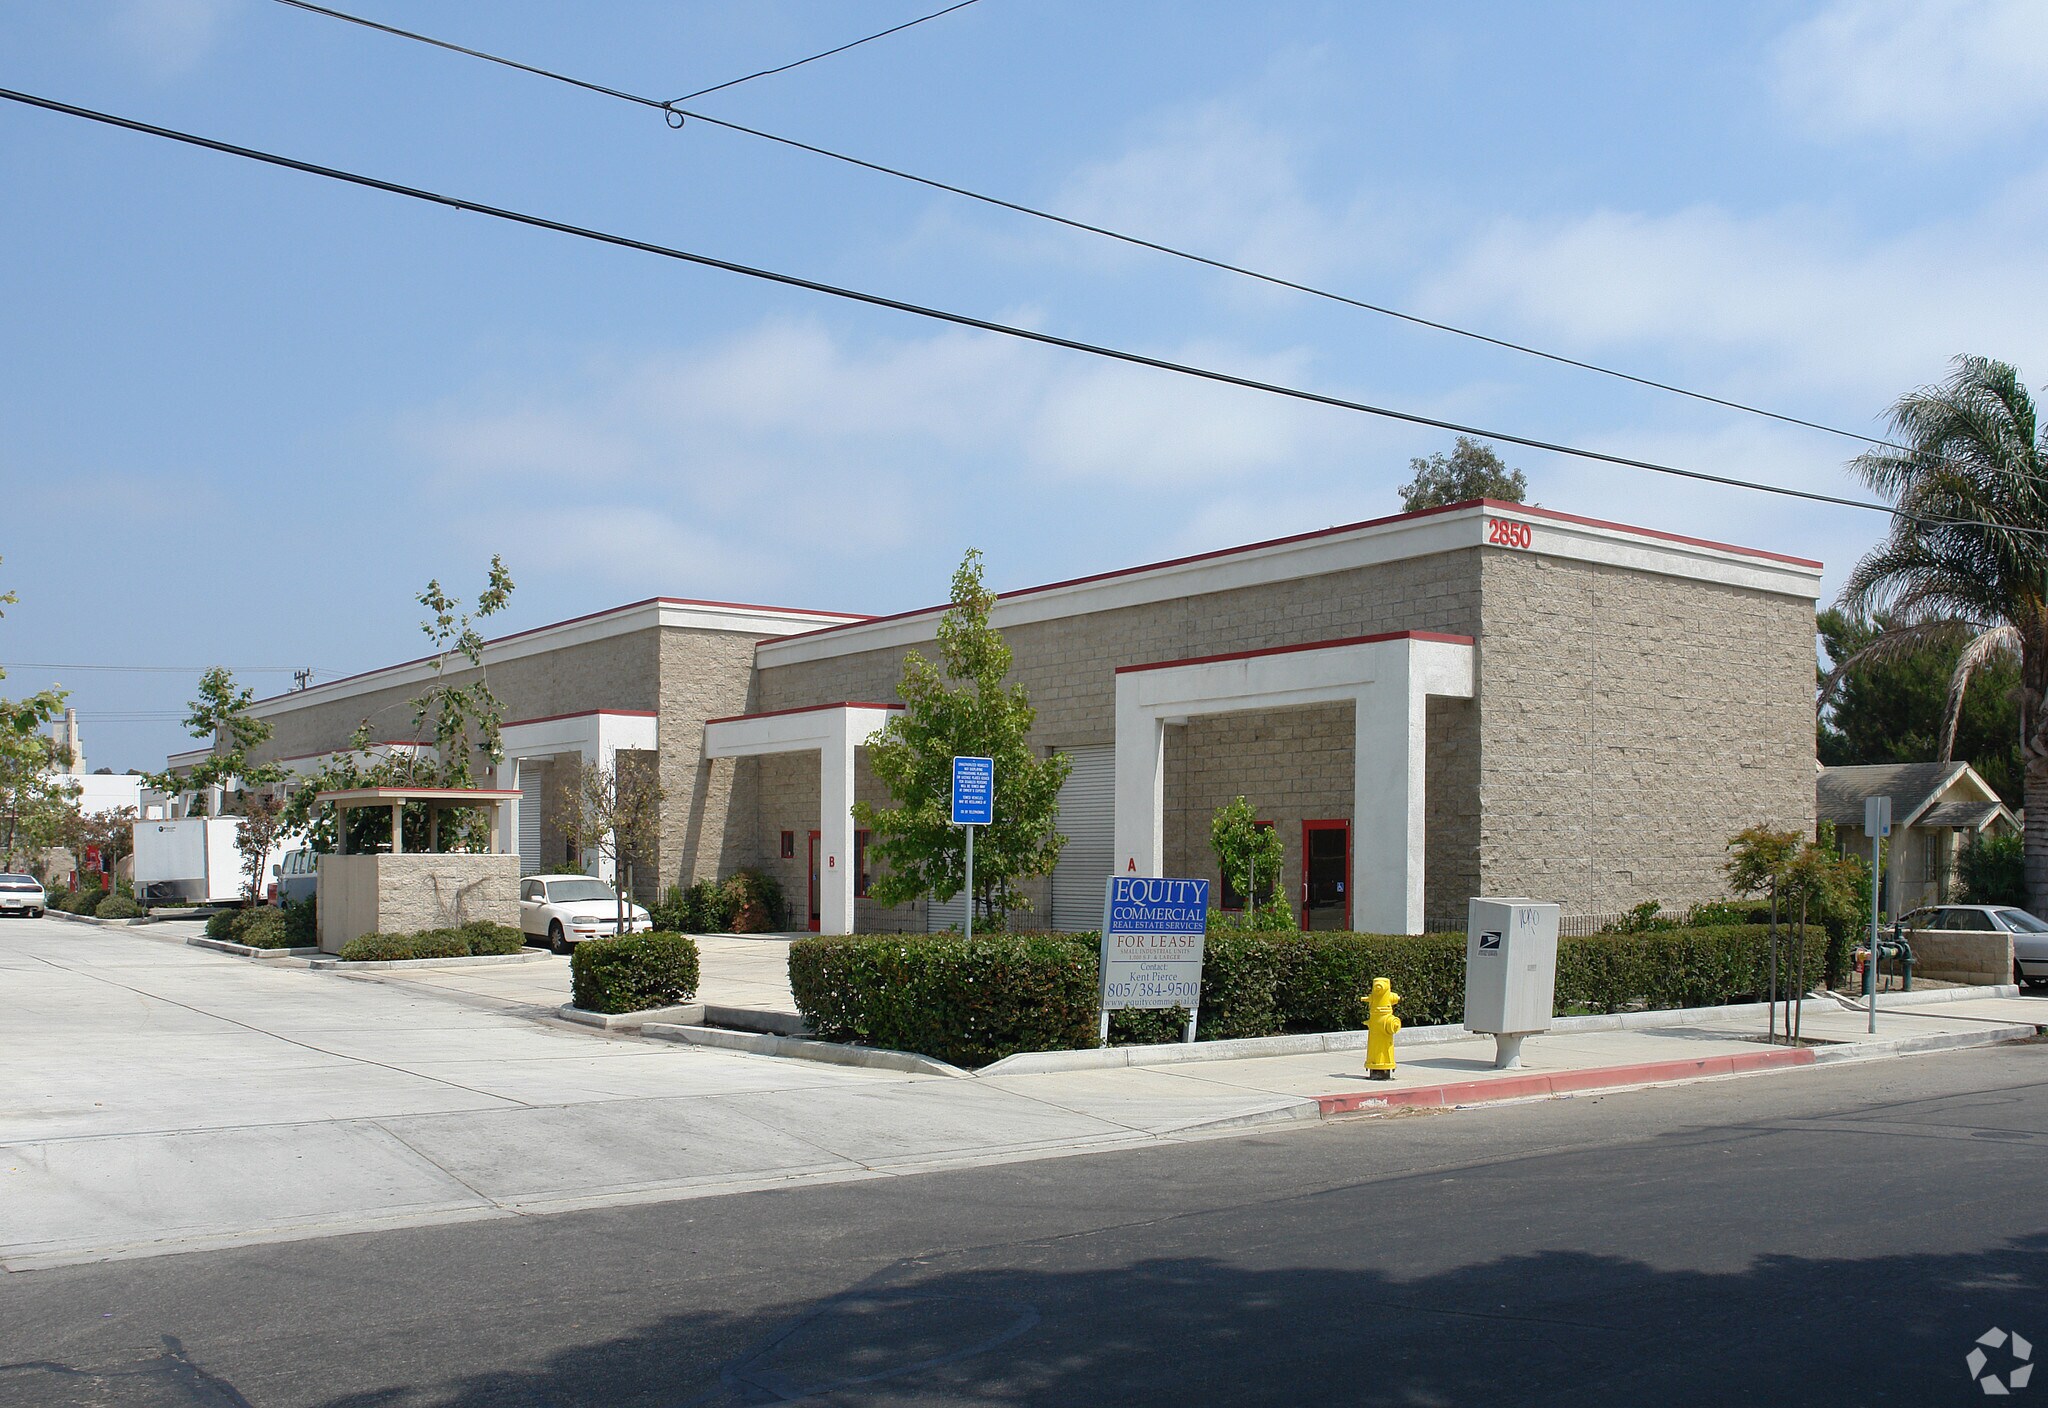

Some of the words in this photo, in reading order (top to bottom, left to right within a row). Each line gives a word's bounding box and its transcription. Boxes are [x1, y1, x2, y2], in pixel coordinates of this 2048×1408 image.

[1489, 518, 1531, 548] 2850
[829, 855, 835, 867] B
[1127, 857, 1136, 872] A
[1115, 879, 1207, 906] EQUITY
[1113, 907, 1204, 921] COMMERCIAL
[1135, 921, 1164, 929] ESTATE
[1165, 922, 1203, 930] SERVICES
[1117, 935, 1145, 948] FOR
[1151, 935, 1196, 948] LEASE
[1140, 963, 1168, 971] Contact:
[1130, 972, 1150, 982] Kent
[1152, 972, 1178, 981] Pierce
[1107, 982, 1198, 998] 805/384-9500
